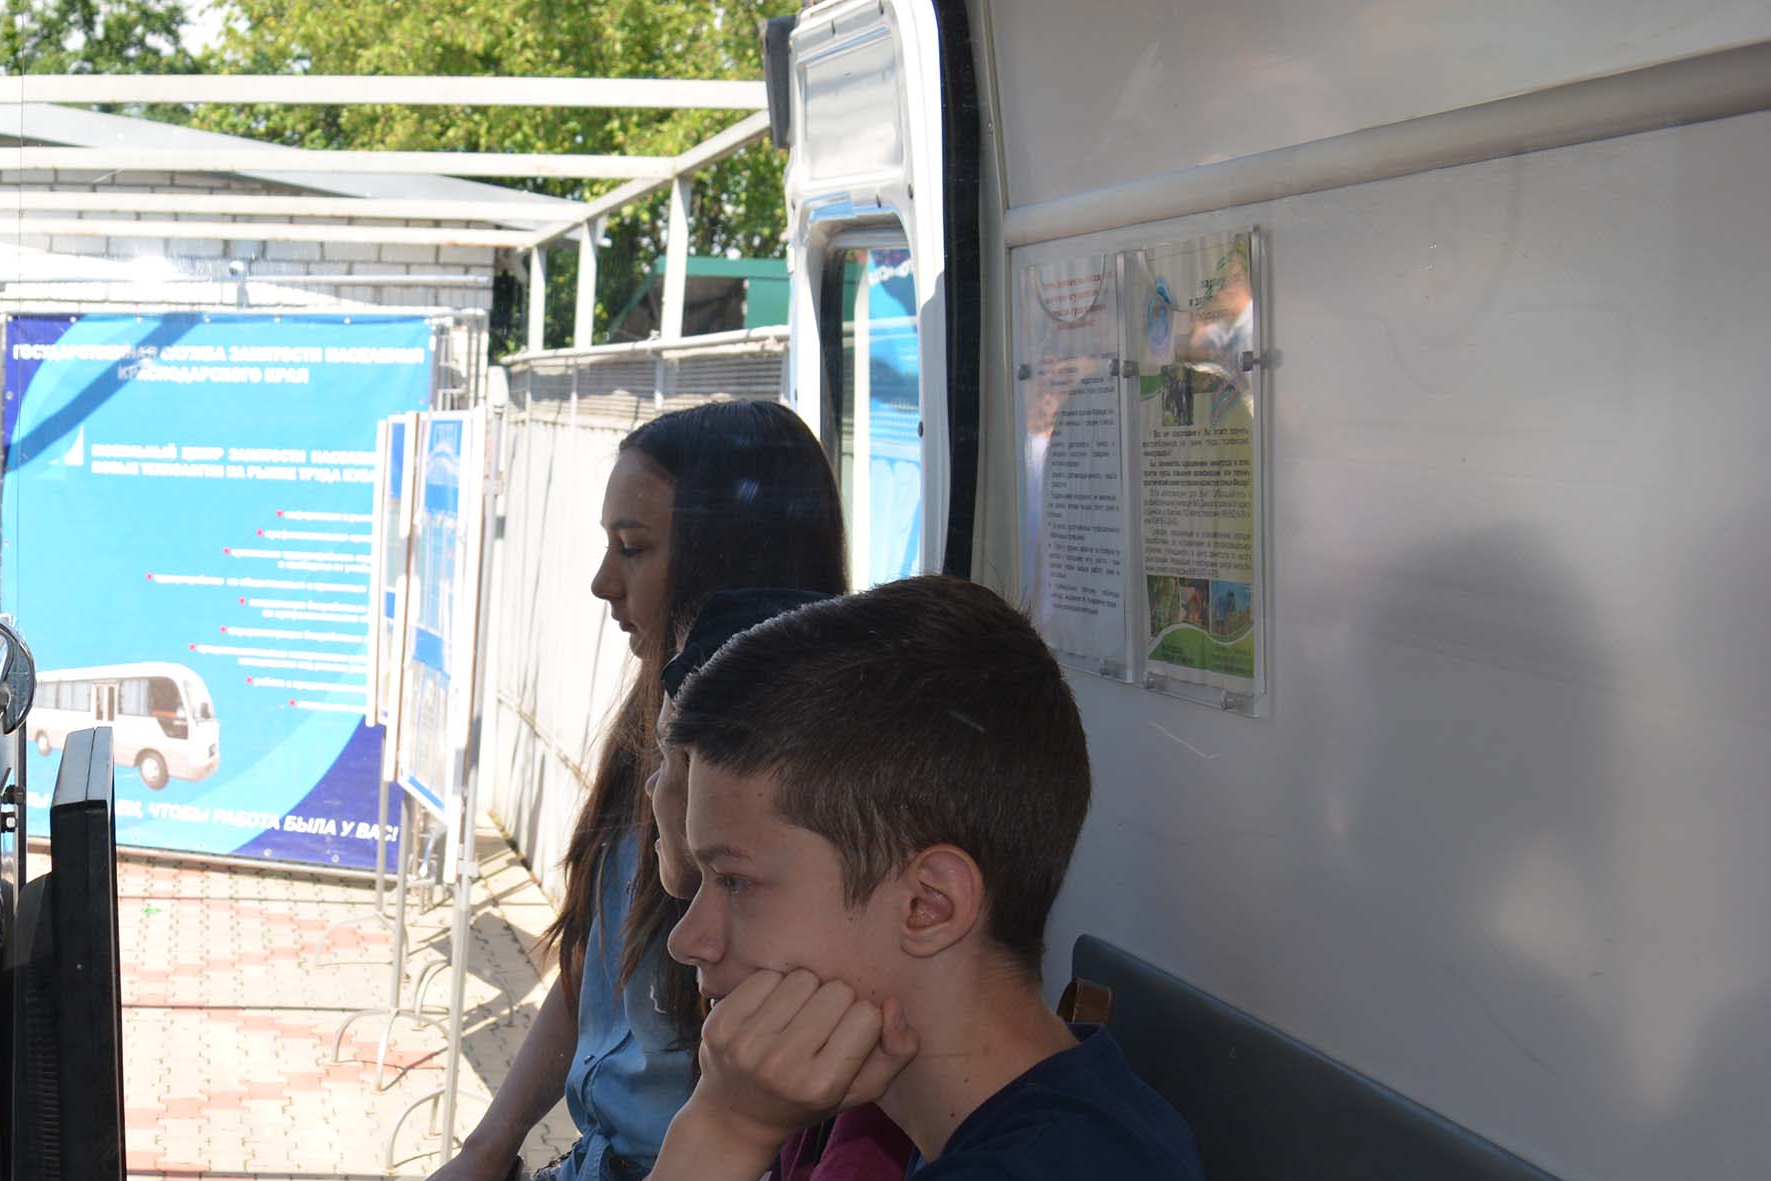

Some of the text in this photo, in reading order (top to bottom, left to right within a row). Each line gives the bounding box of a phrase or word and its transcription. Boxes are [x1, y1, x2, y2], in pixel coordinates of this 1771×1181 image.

[147, 801, 211, 822] ЧТОБЫ
[211, 807, 280, 831] РАБОТА
[284, 814, 337, 837] БЫЛА
[340, 821, 356, 838] У
[356, 821, 399, 842] ВАС!
